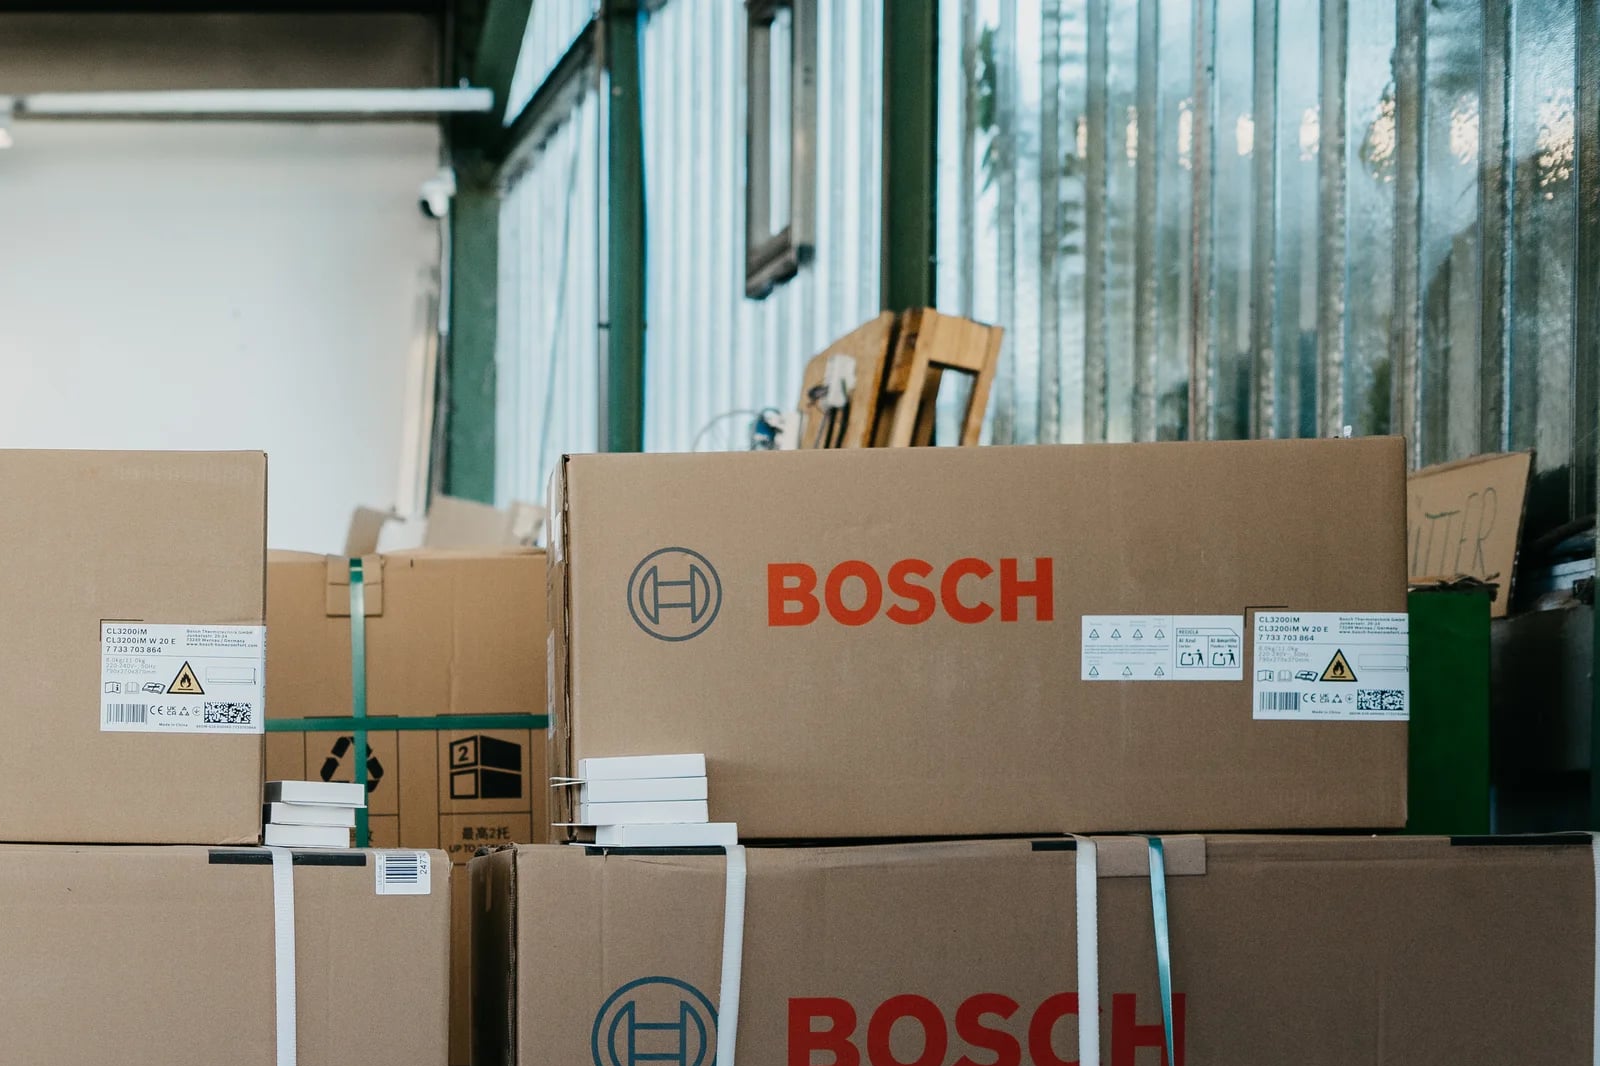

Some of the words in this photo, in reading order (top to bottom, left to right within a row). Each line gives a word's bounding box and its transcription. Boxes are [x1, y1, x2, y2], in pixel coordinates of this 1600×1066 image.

[767, 557, 1054, 626] BOSCH
[1303, 693, 1316, 703] CE
[149, 705, 164, 715] CE
[459, 746, 469, 762] 2
[449, 844, 462, 853] UP
